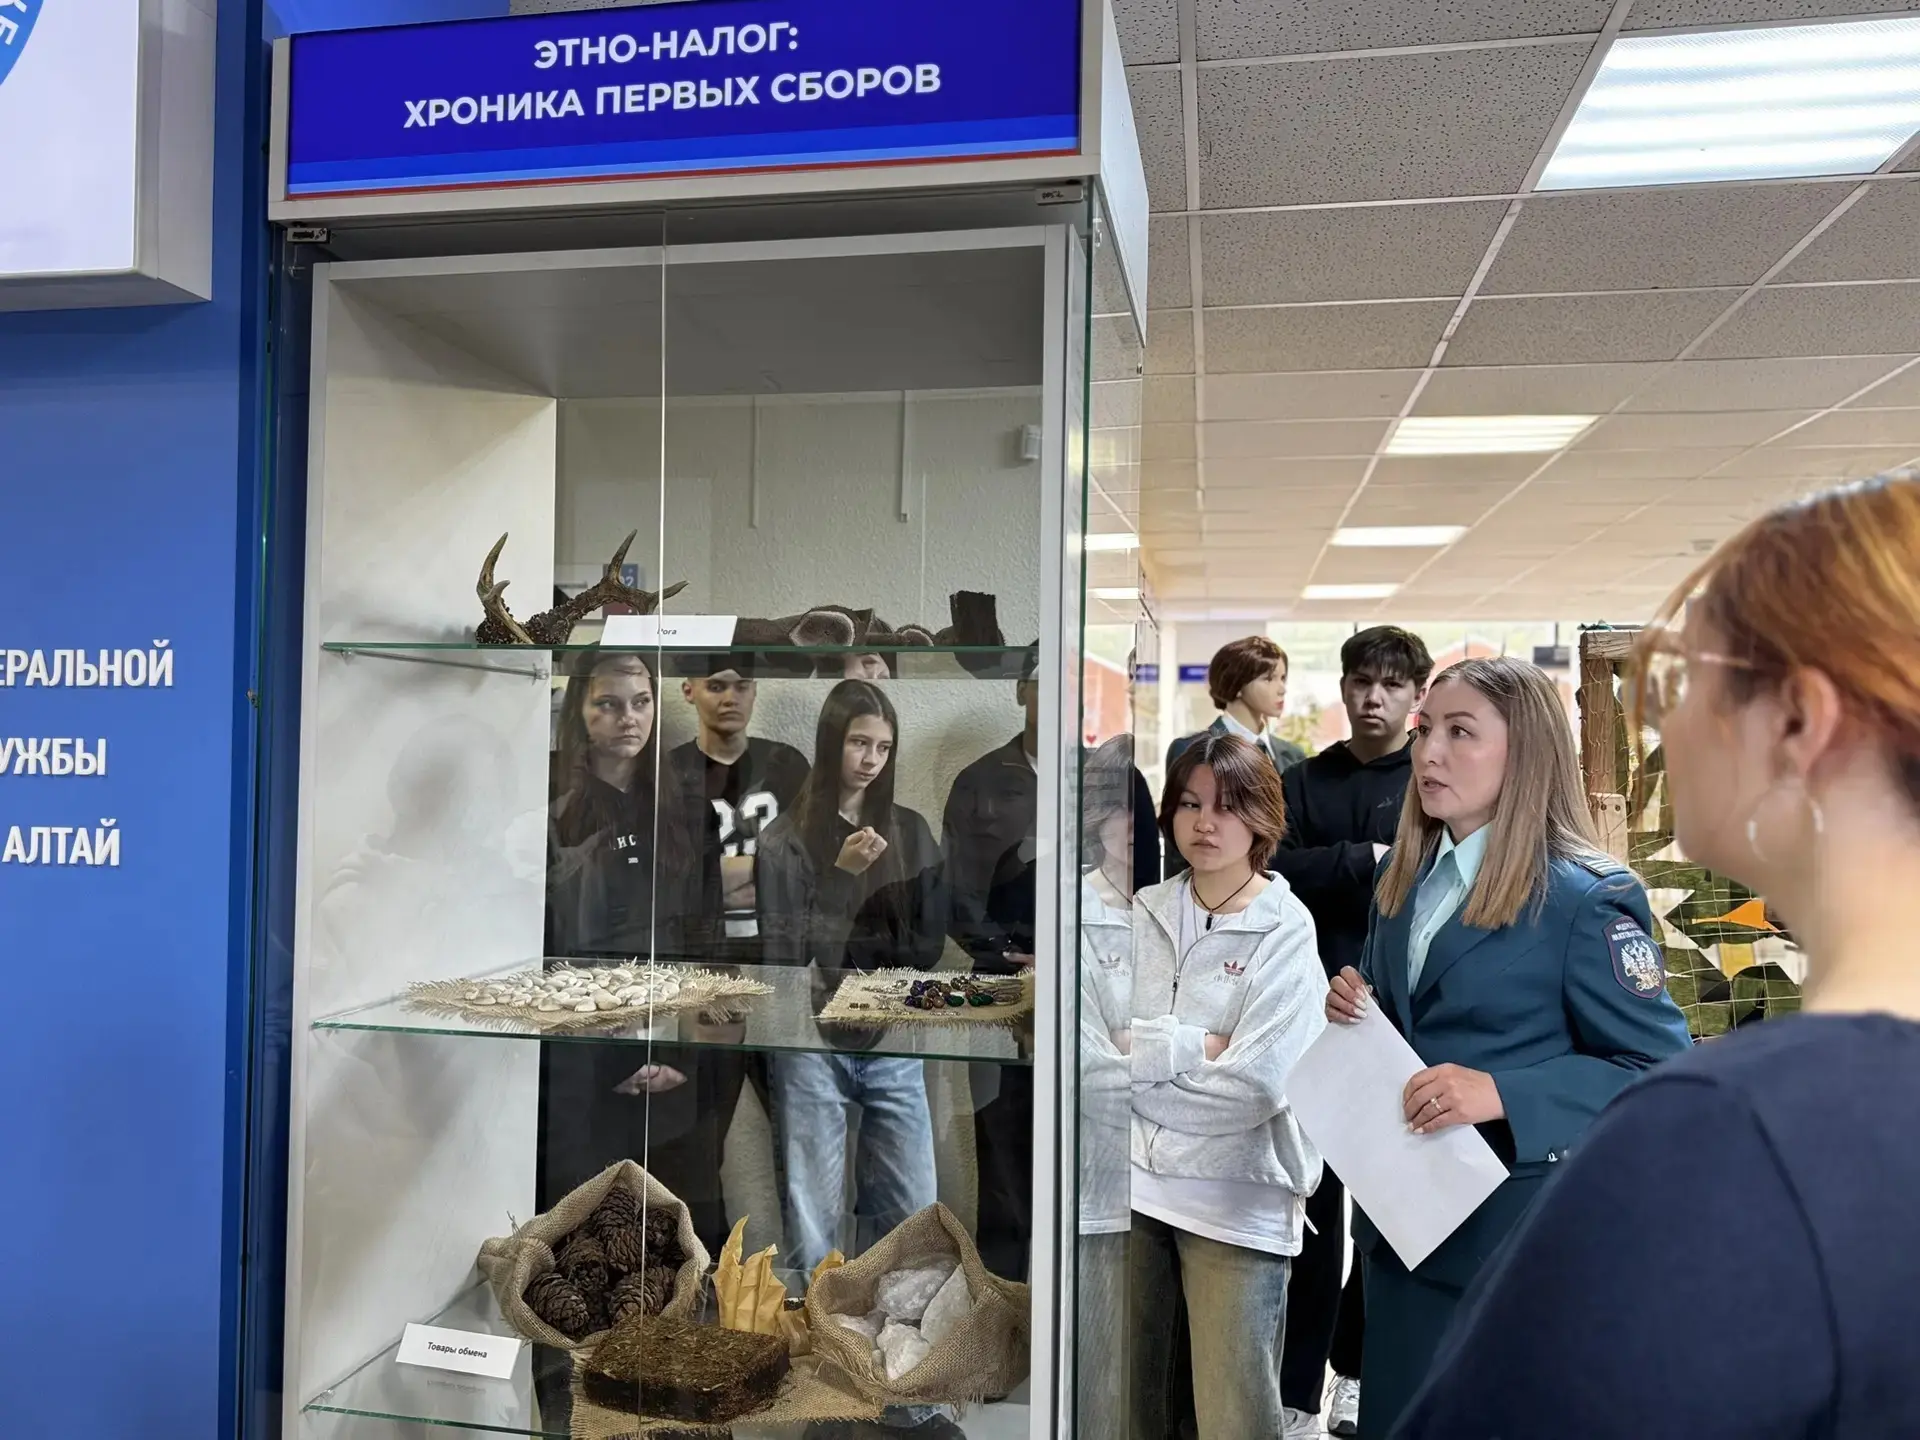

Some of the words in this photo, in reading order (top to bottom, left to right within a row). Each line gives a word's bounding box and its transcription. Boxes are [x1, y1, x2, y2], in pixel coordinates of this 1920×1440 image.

[533, 21, 798, 69] ЭТНО-НАЛОГ:
[403, 88, 585, 129] ХРОНИКА
[596, 75, 761, 115] ПЕРВЫХ
[770, 63, 942, 103] СБОРОВ
[1, 817, 121, 867] АЛТАЙ
[427, 1341, 457, 1354] Товары
[458, 1347, 488, 1359] обмена
